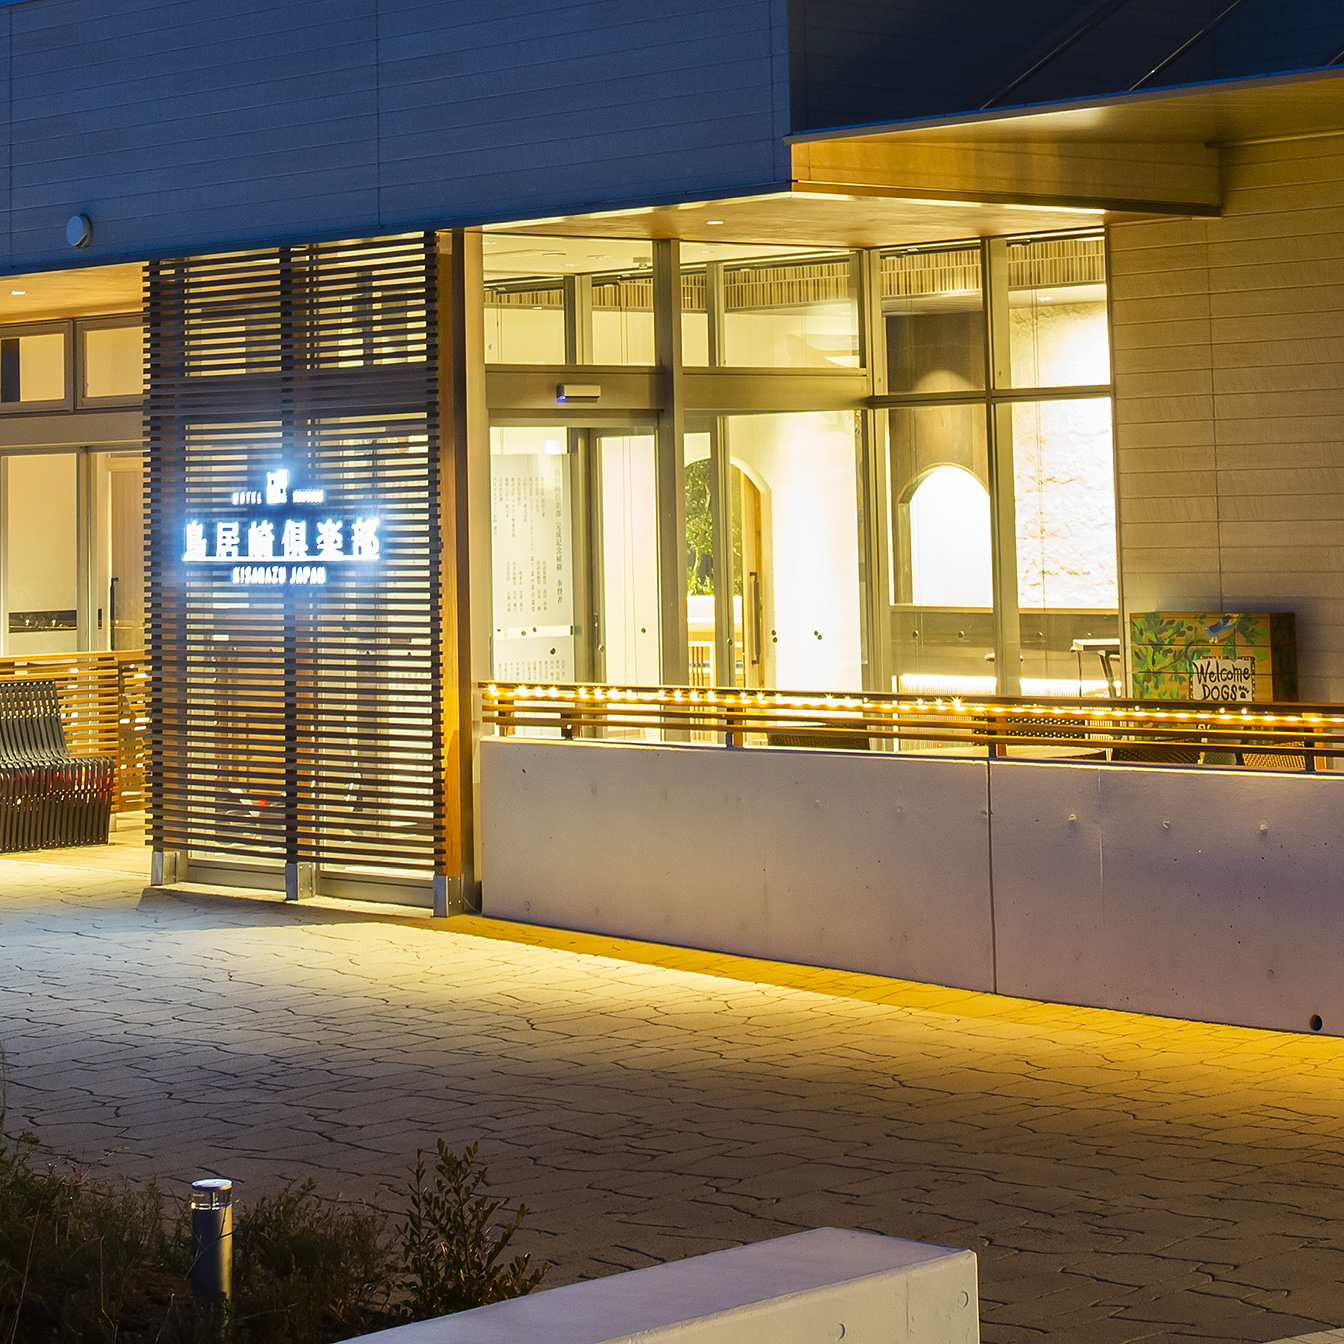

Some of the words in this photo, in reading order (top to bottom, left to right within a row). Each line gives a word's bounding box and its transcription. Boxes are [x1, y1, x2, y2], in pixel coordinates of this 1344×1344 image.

[232, 566, 286, 584] KISARAZU
[290, 566, 326, 584] JAPAN
[1193, 660, 1250, 684] Welcome
[1202, 684, 1237, 701] DOGS
